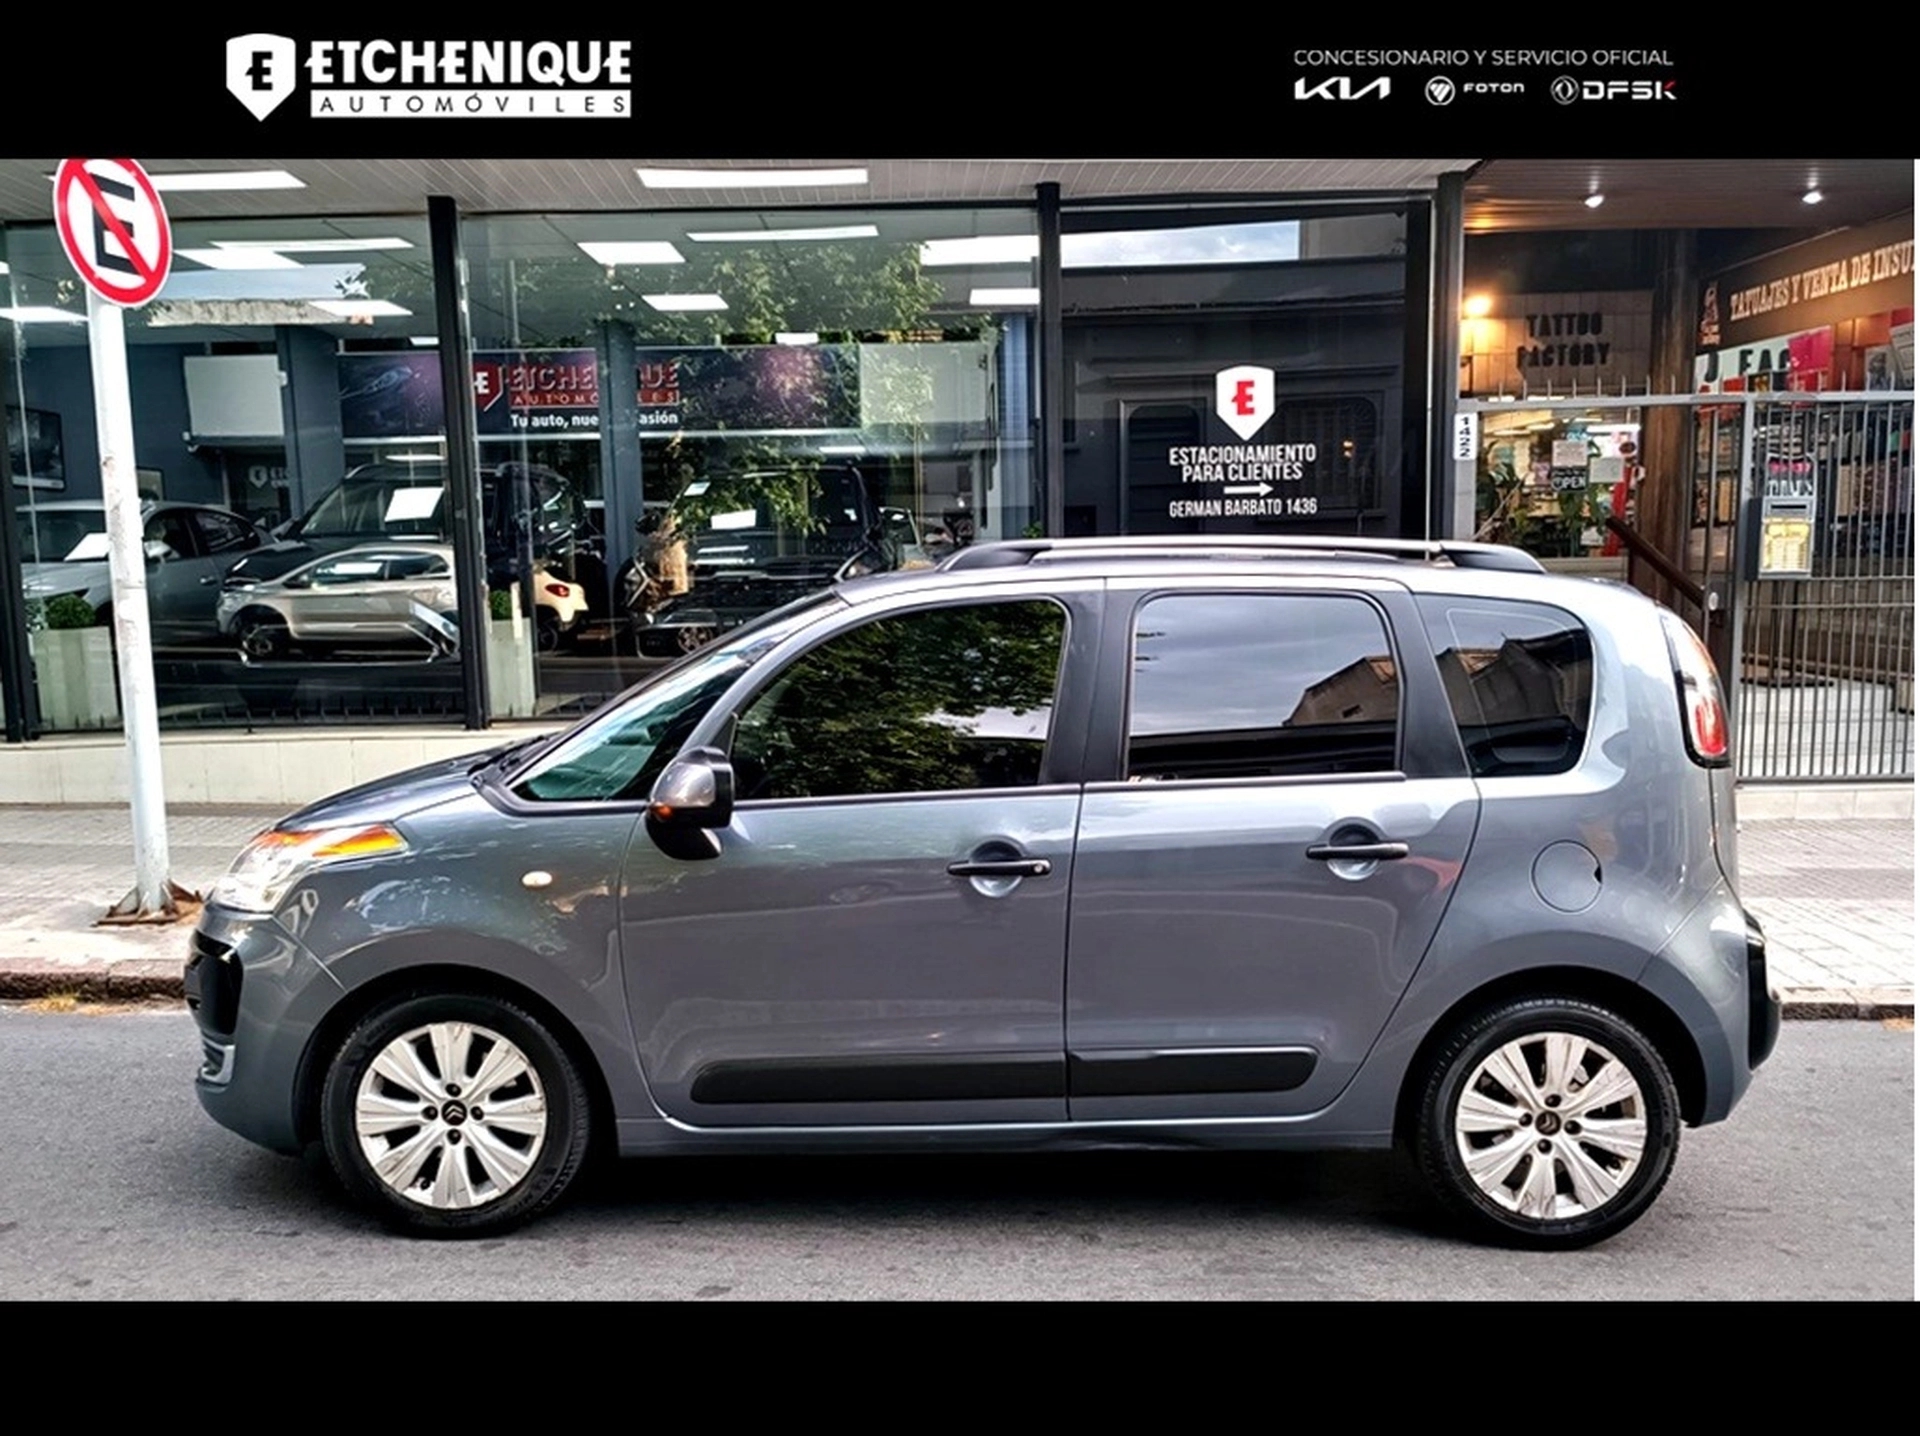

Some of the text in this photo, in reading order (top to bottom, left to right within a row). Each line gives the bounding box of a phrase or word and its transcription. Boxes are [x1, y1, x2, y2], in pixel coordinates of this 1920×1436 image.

[91, 172, 143, 277] E
[1730, 239, 1914, 321] TATUAJES Y VENTA DE INSU
[1525, 312, 1603, 337] TATTOO
[1516, 342, 1610, 370] FACTORY
[511, 411, 678, 429] Tu auto, nue asión
[1459, 416, 1471, 457] 1422
[1169, 443, 1317, 466] ESTACIONAMIENTO
[1182, 462, 1303, 482] PARA CLIENTES
[1169, 497, 1318, 518] GERMAN BARBATO 1436
